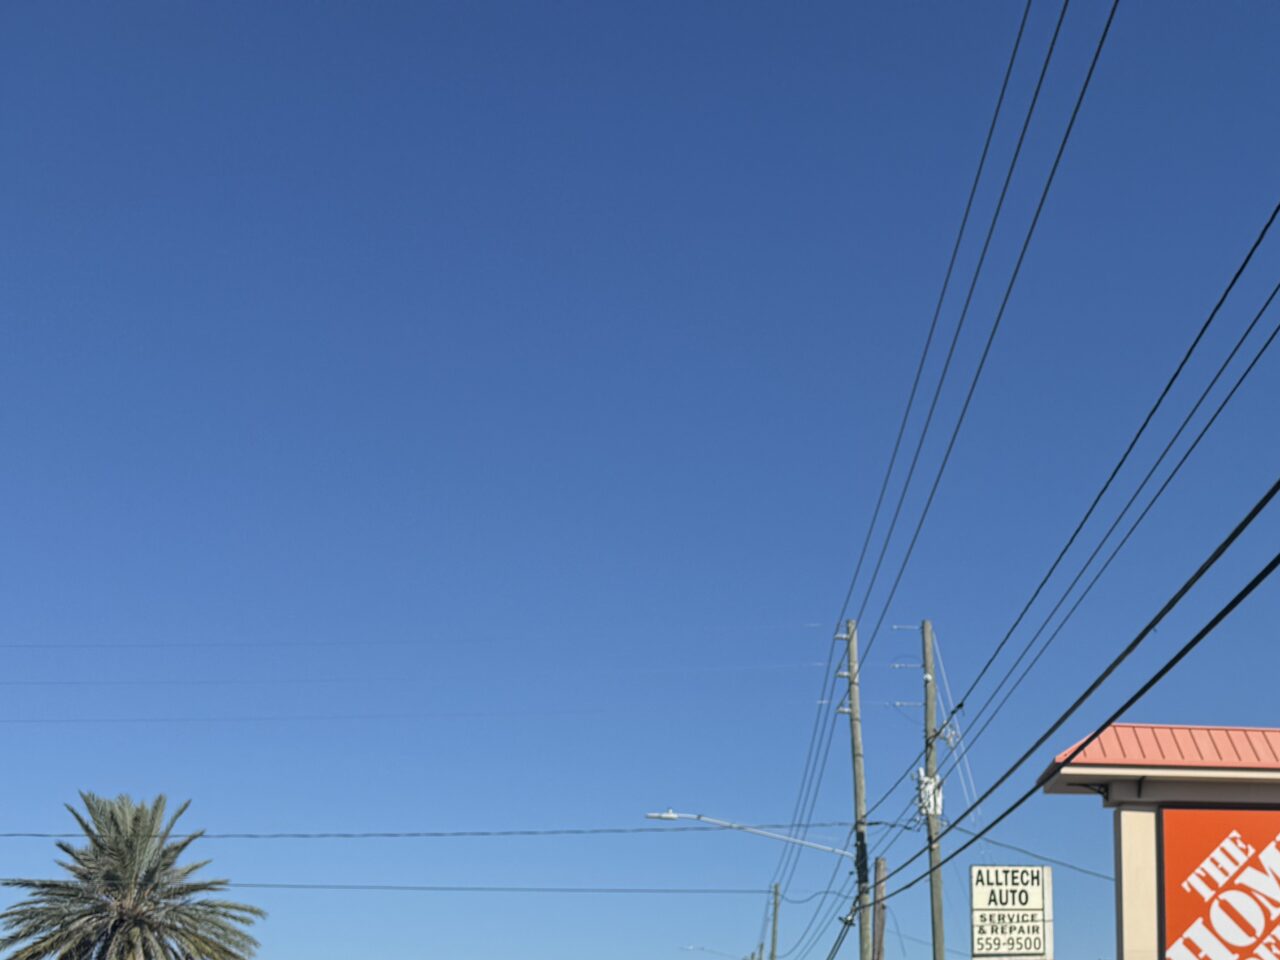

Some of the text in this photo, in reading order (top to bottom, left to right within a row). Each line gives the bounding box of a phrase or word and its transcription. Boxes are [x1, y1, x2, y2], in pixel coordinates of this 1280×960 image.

[1181, 829, 1256, 903] THE
[975, 869, 1040, 887] ALLTECH
[988, 889, 1029, 906] AUTO
[979, 913, 1039, 924] SERVICE
[978, 925, 1040, 935] & REPAIR
[976, 937, 1042, 951] 559-9500
